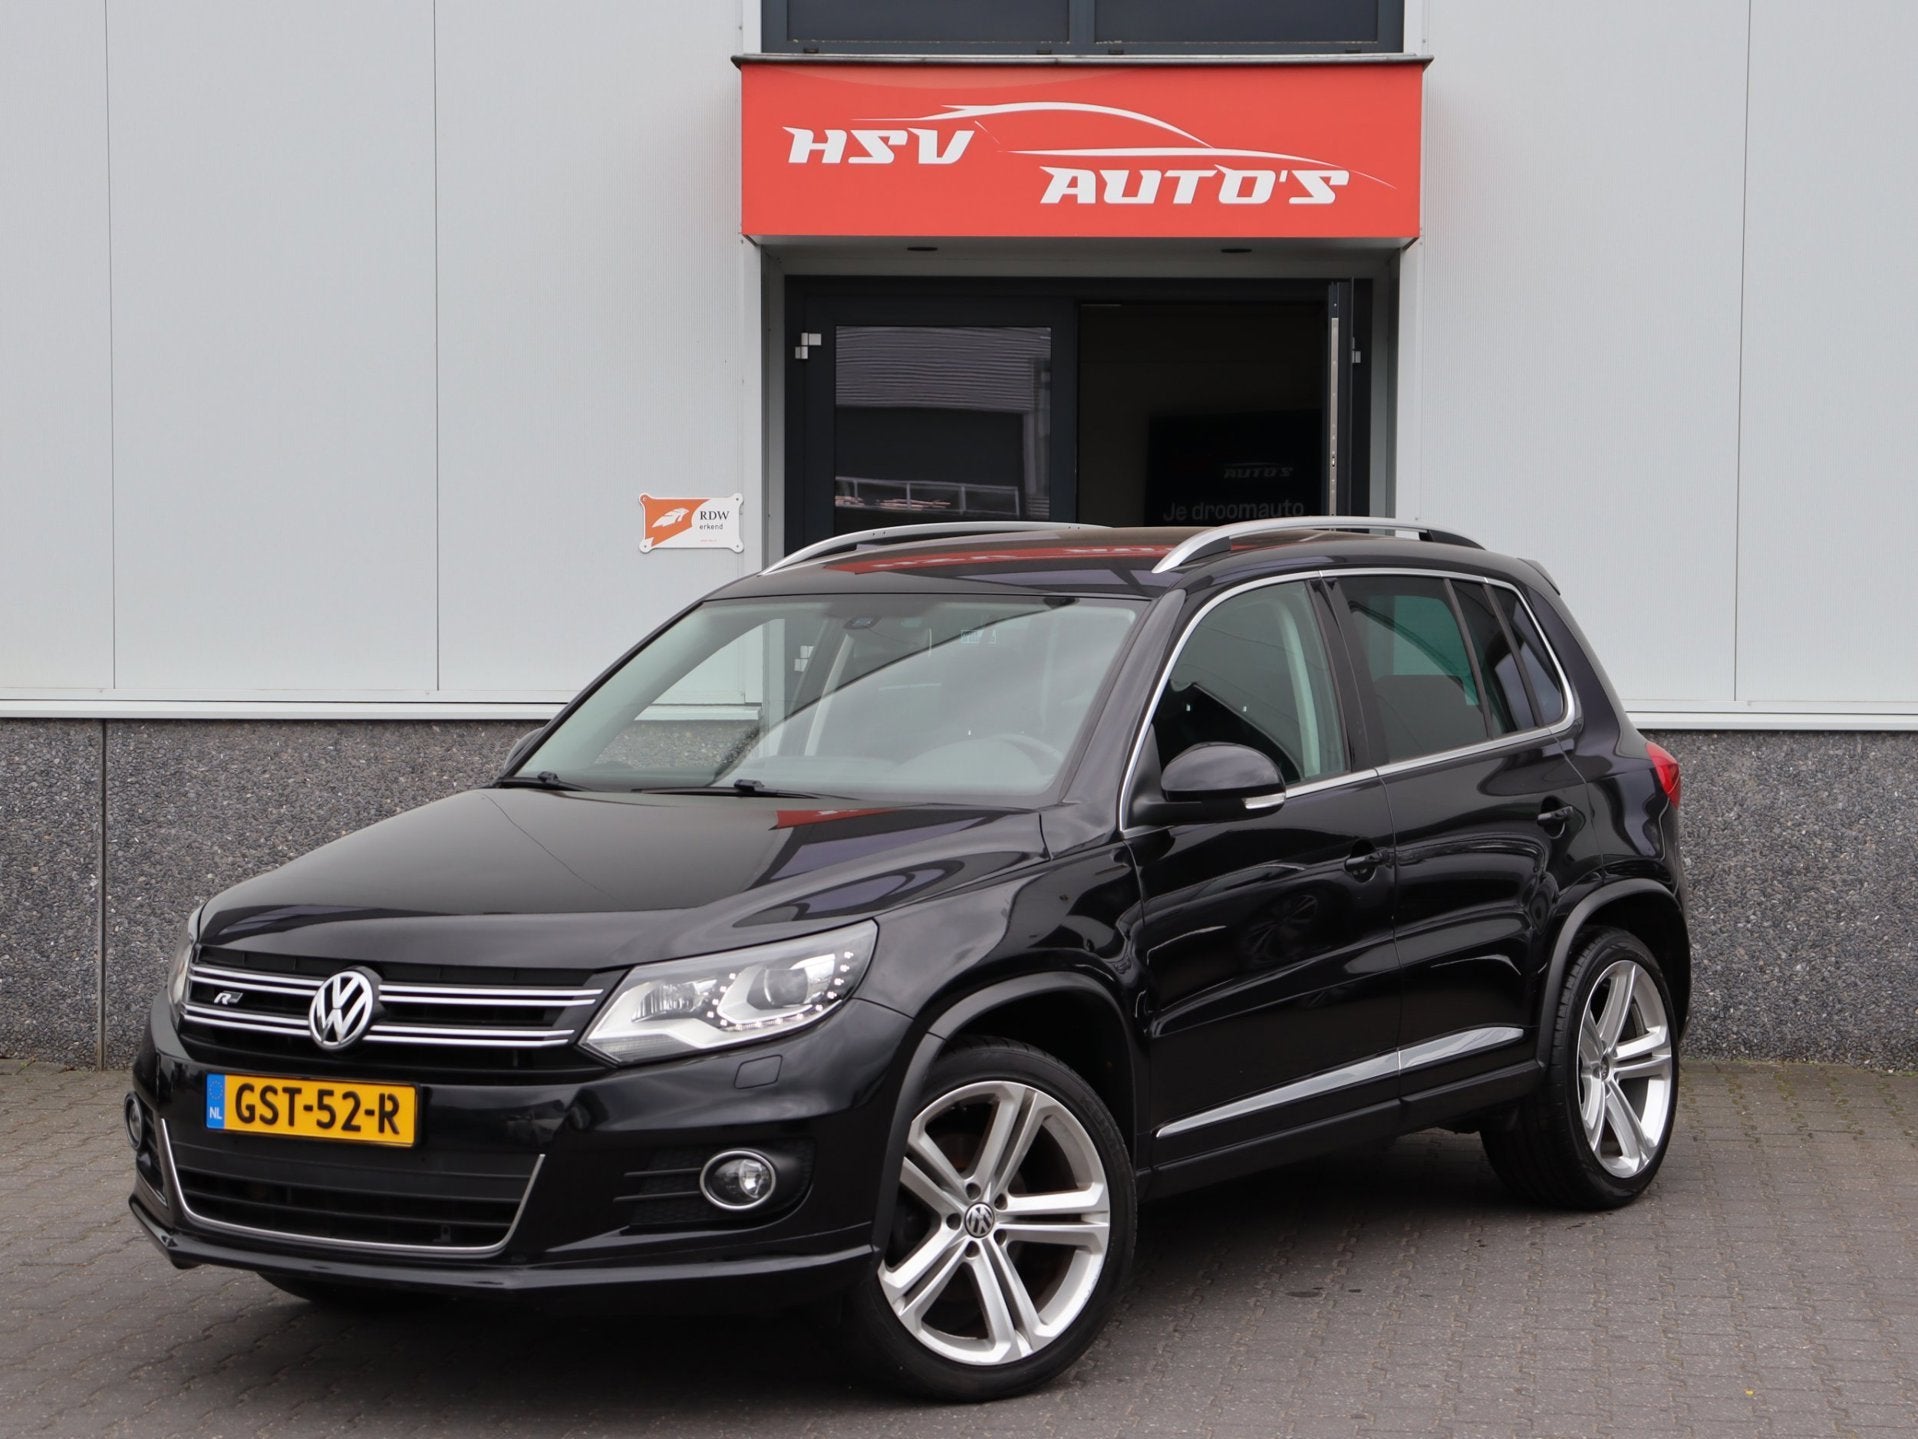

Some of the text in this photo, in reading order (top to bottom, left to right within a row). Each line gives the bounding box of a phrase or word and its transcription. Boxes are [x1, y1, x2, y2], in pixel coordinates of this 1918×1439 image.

[782, 126, 974, 164] HSV
[1039, 164, 1350, 205] AUTO'S
[1224, 467, 1294, 479] AUTOS
[700, 510, 729, 520] RDW
[1163, 499, 1304, 522] Je droomauto
[209, 1107, 223, 1120] NL
[235, 1083, 401, 1135] GST-52-R
